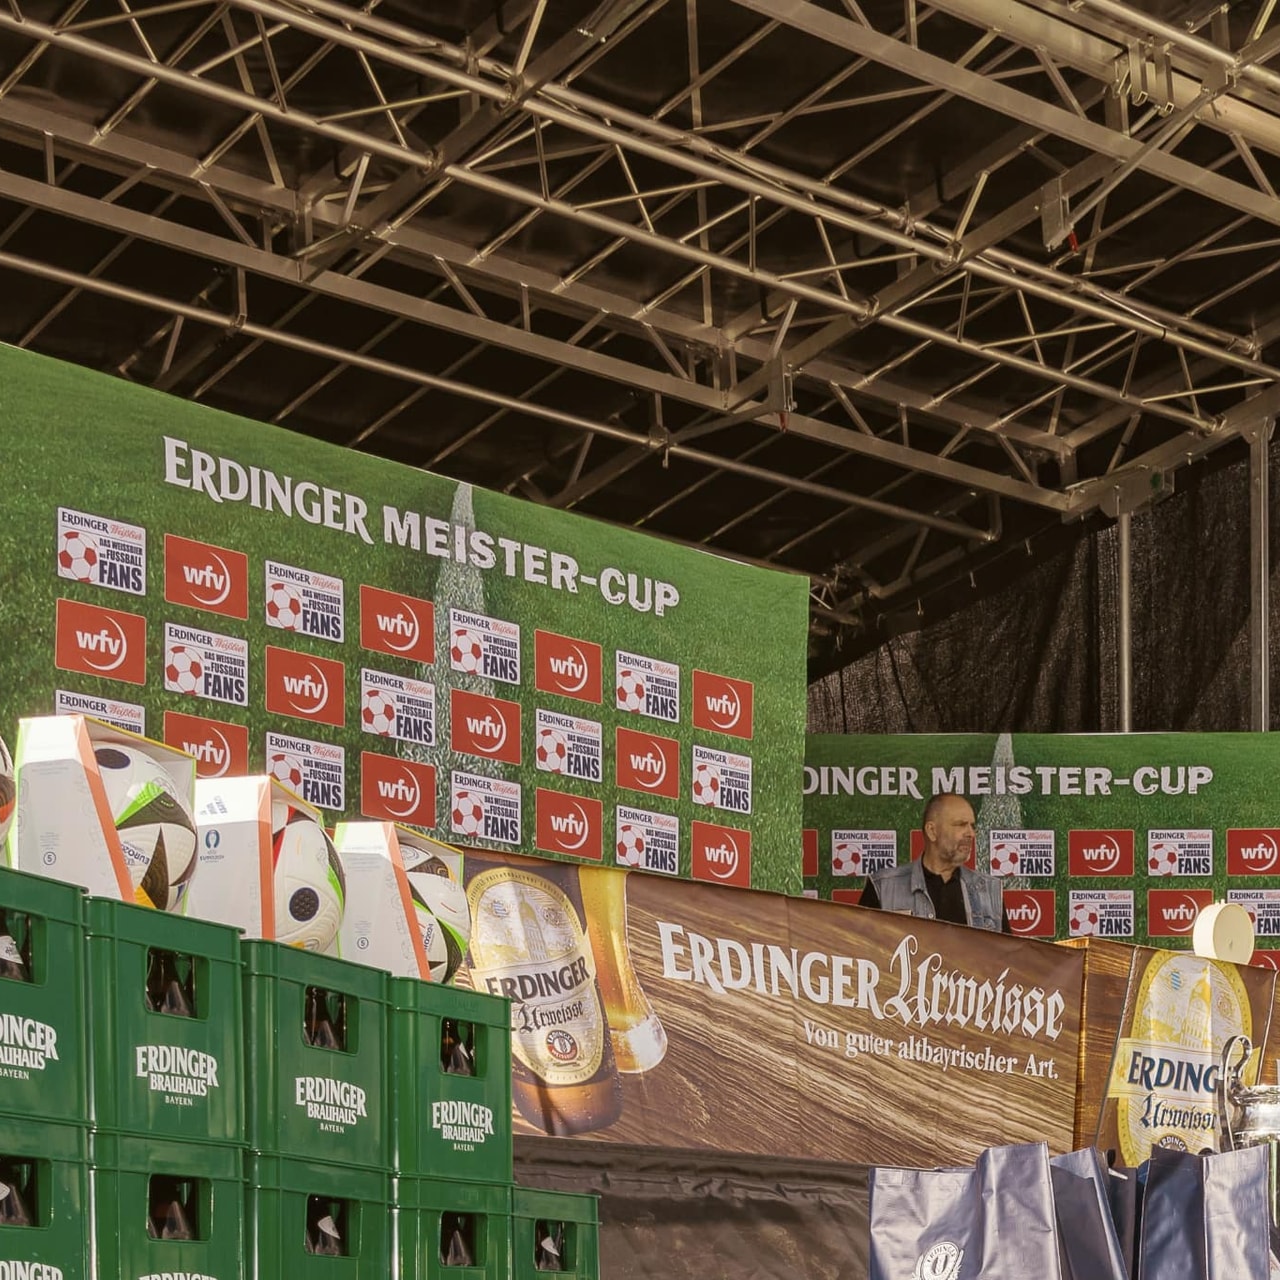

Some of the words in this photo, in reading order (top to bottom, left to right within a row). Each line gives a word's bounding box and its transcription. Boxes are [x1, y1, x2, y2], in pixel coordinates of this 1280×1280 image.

[62, 511, 108, 534] ERDINGER
[162, 435, 374, 545] ERDINGER
[383, 506, 679, 616] MEISTER-CUP
[99, 560, 142, 593] FANS
[183, 565, 225, 590] wfv
[269, 564, 310, 585] ERDINGER
[302, 609, 340, 640] FANS
[377, 614, 414, 637] wfv
[454, 612, 490, 631] ERDINGER
[76, 630, 120, 655] wfv
[169, 626, 213, 647] ERDINGER
[483, 654, 517, 682] FANS
[550, 657, 583, 678] wfv
[619, 653, 652, 671] ERDINGER
[204, 673, 244, 703] FANS
[283, 675, 322, 699] wfv
[365, 672, 403, 690] ERDINGER
[645, 693, 676, 720] FANS
[396, 715, 432, 744] FANS
[466, 716, 502, 738] wfv
[630, 753, 662, 774] wfv
[802, 766, 924, 800] DINGER
[932, 766, 1214, 796] MEISTER-CUP
[993, 832, 1027, 840] ERDINGER
[1083, 844, 1116, 860] wfv
[1241, 843, 1273, 860] wfv
[1020, 859, 1052, 874] FANS
[1178, 858, 1210, 874] FANS
[485, 956, 590, 1004] ERDINGER
[656, 921, 885, 1021] ERDINGER
[883, 935, 1065, 1041] Urweisse
[803, 1021, 839, 1049] Von
[846, 1031, 894, 1058] guter
[898, 1038, 1018, 1075] altbayrischer
[1023, 1053, 1059, 1081] Art.
[135, 1045, 219, 1087] ERDINGER
[1127, 1051, 1219, 1094] ERDING
[149, 1073, 207, 1096] BRAUHAUS
[165, 1095, 193, 1106] BAYERN
[431, 1100, 494, 1134] ERDINGER
[442, 1124, 485, 1143] BRAUHAUS
